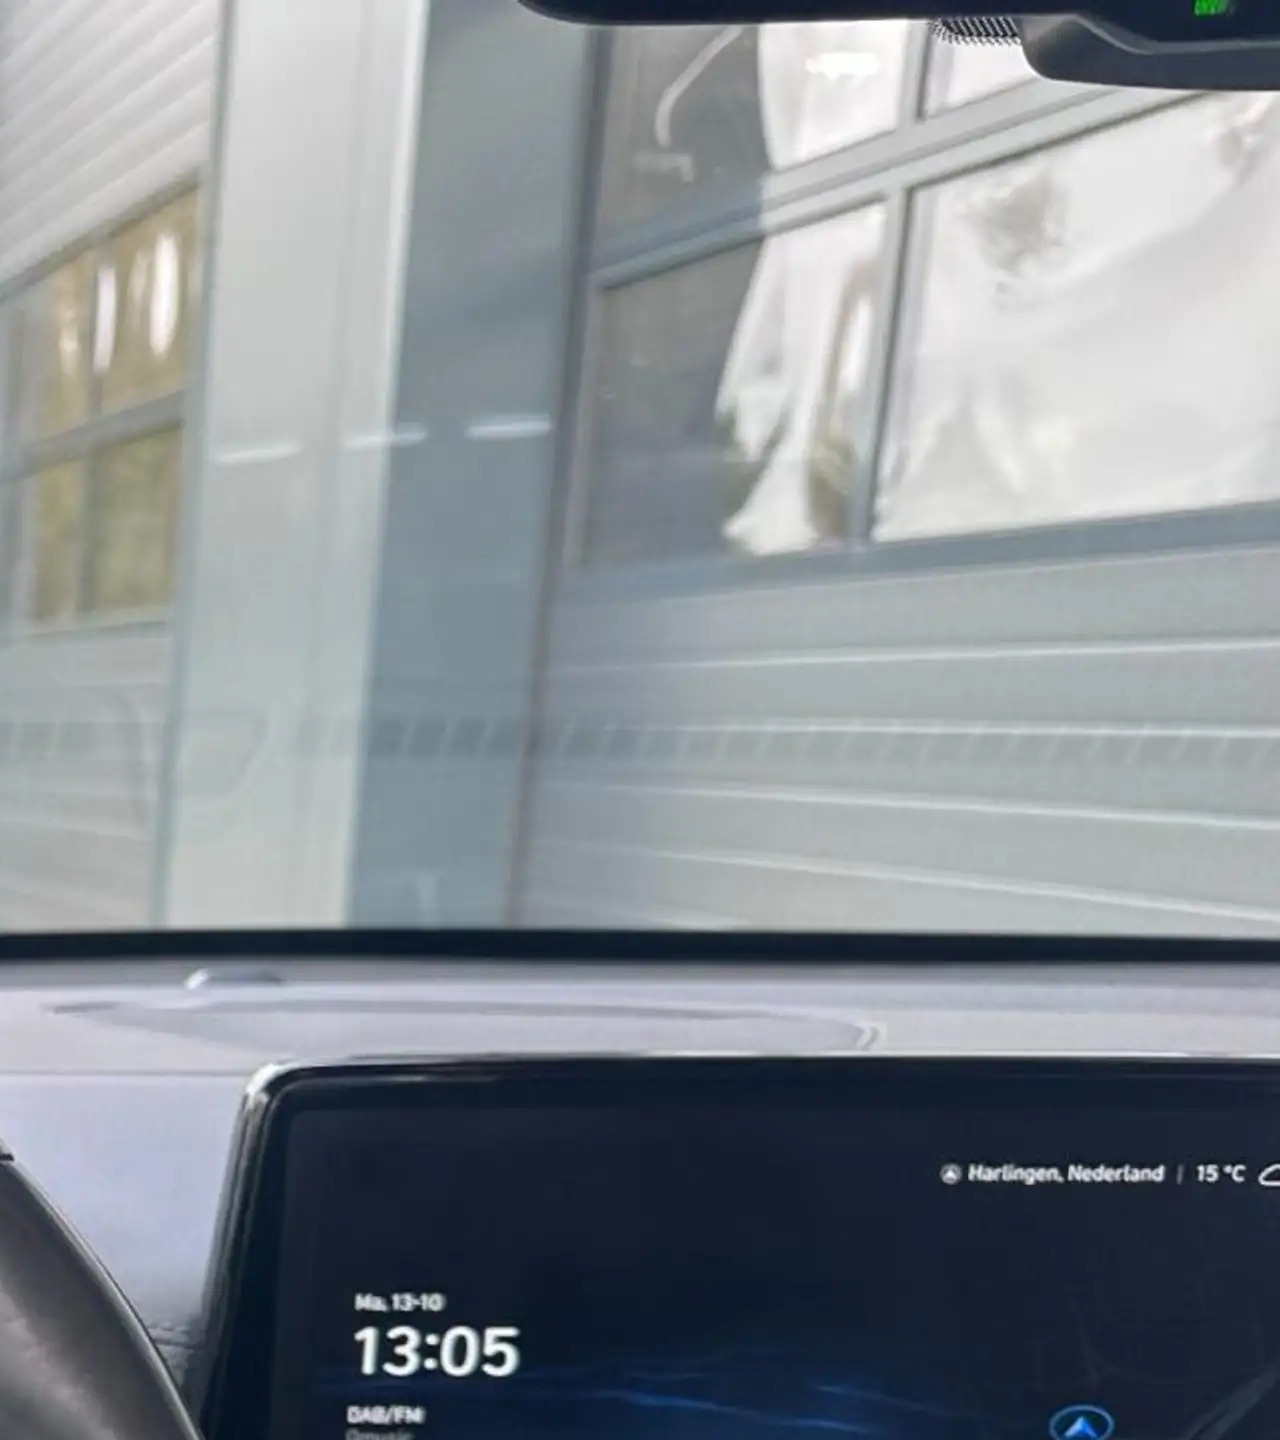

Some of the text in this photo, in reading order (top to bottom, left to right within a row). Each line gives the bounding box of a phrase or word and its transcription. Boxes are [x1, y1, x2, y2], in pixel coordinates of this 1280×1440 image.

[967, 1163, 1166, 1185] Harlingen, Nederland
[353, 1325, 521, 1377] 13:05
[347, 1405, 426, 1424] DAB/FM
